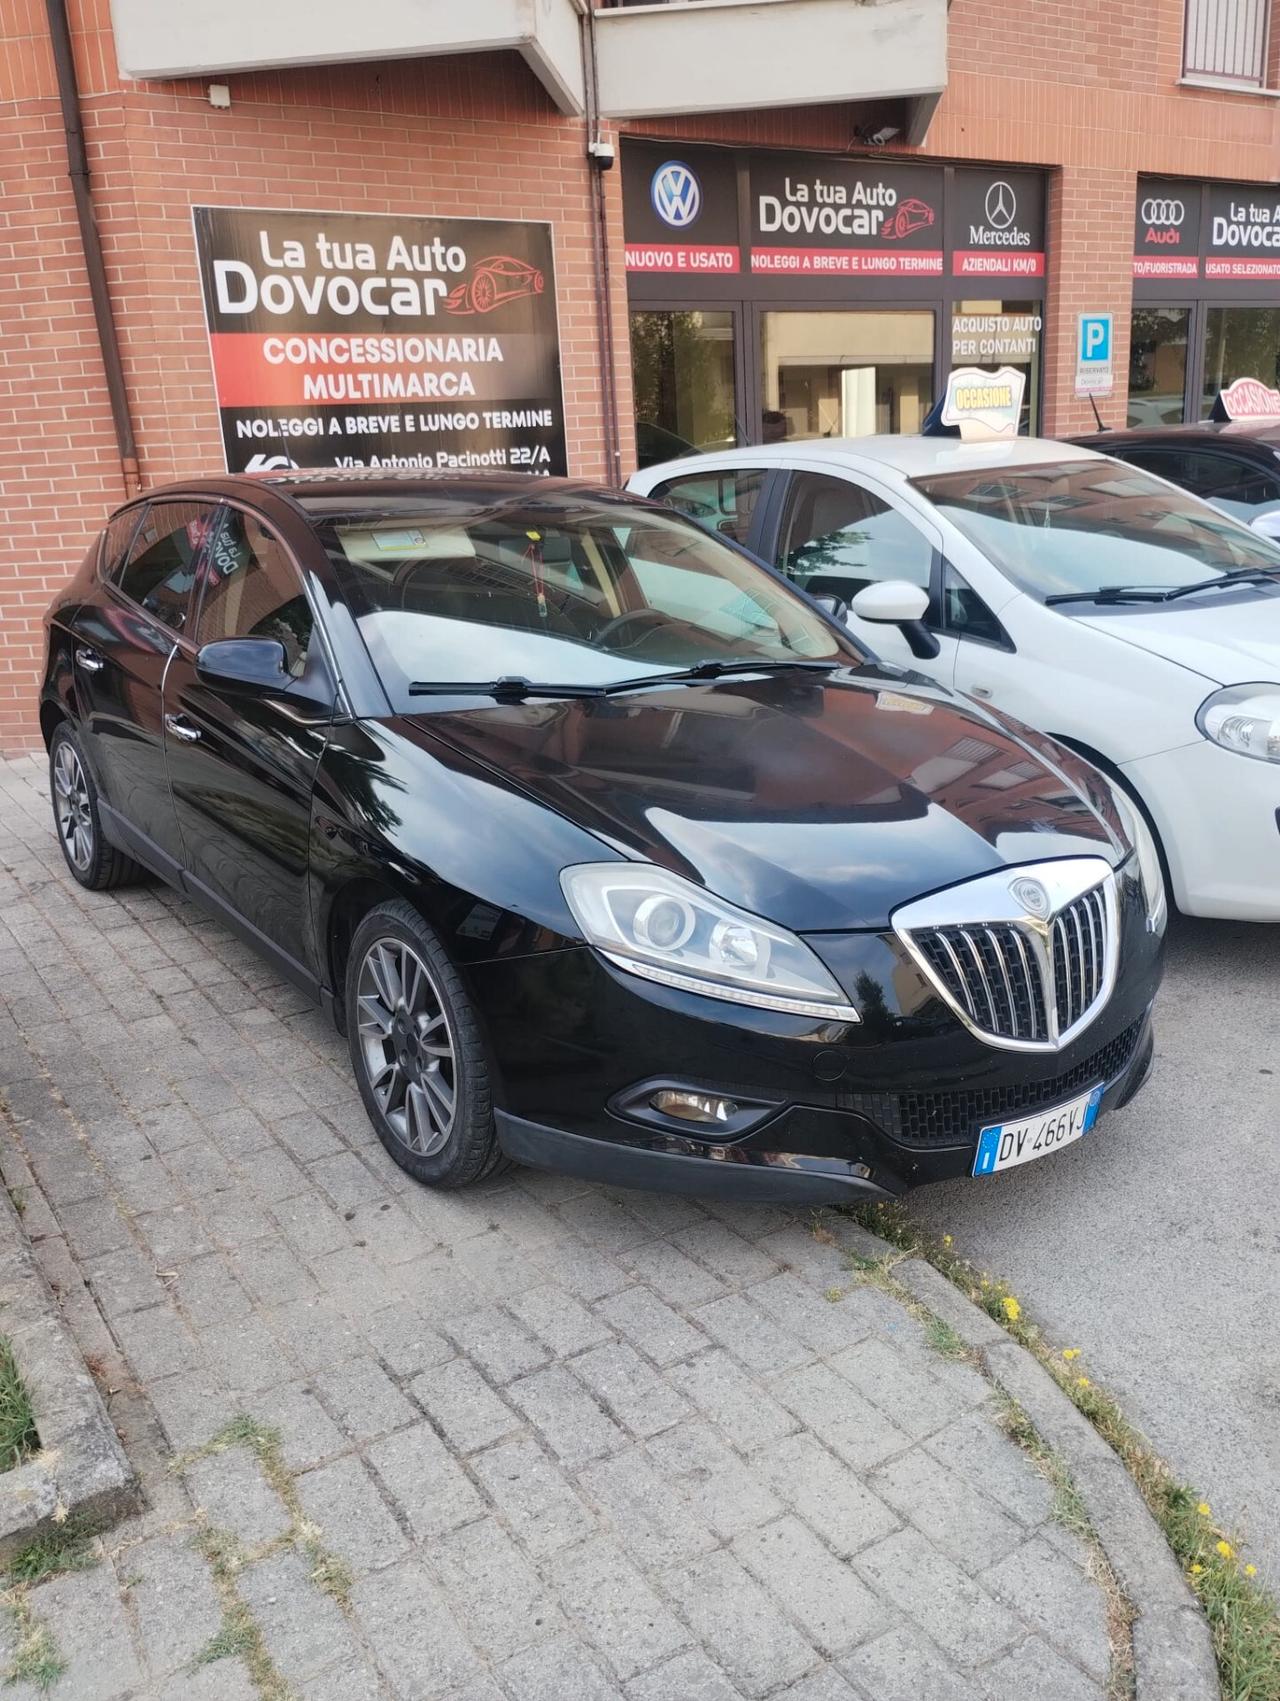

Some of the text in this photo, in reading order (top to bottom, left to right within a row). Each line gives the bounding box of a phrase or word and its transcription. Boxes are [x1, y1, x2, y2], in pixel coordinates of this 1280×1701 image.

[785, 177, 897, 206] La tua Auto
[759, 196, 884, 235] Dovocar
[1230, 202, 1246, 221] La
[1249, 203, 1270, 223] tua
[969, 225, 1031, 246] Mercedes
[1145, 227, 1180, 244] Audi
[1212, 216, 1280, 247] Dovoca
[259, 230, 466, 273] La tua Auto
[625, 251, 733, 268] NUOVO E USATO
[751, 254, 943, 270] NOLEGGI A BREVE E LUNGO TERMINE
[962, 257, 1011, 272] AZIENDALI
[1205, 262, 1280, 275] USATO SELEZIONATO
[213, 260, 448, 316] Dovocar
[952, 316, 1042, 334] ACQUISTO AUTO
[263, 337, 504, 365] CONCESSIONARIA
[952, 338, 1036, 355] PER CONTANTI
[1086, 322, 1104, 358] P
[304, 372, 476, 401] MULTIMARCA
[956, 385, 1012, 410] OCCASIONE
[1226, 384, 1280, 414] OCCASIONE
[236, 410, 552, 438] NOLEGGI A BREVE E LUNGO TERMINE
[335, 445, 551, 468] Via Antonio Pacinotti 22/A
[999, 1101, 1089, 1161] DV 466VJ
